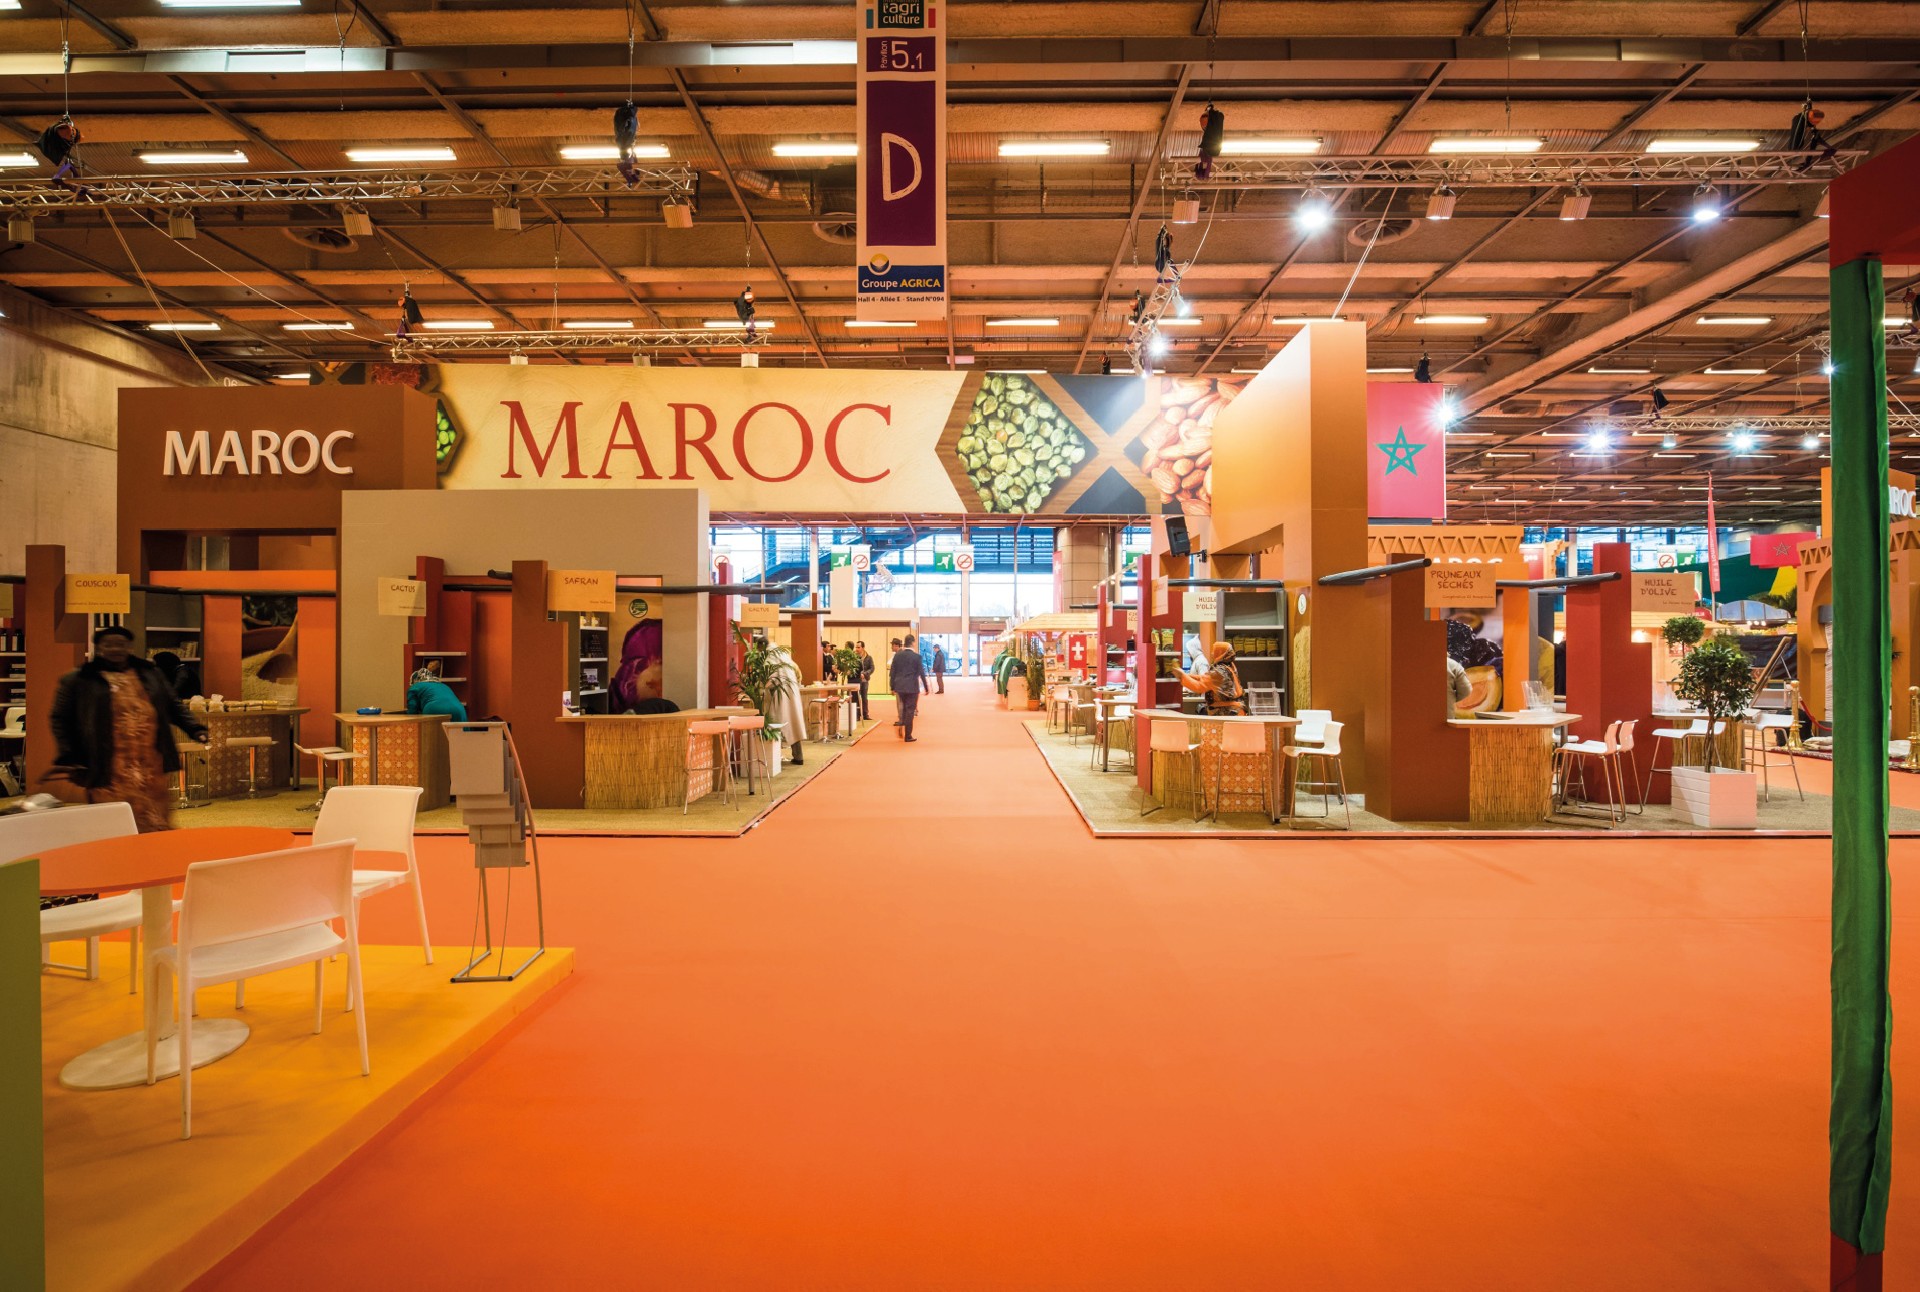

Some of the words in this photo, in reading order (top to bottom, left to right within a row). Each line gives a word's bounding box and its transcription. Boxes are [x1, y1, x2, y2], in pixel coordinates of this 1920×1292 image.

[882, 14, 920, 24] culture
[880, 40, 888, 69] Pavillon
[891, 40, 922, 70] 5.1
[881, 132, 922, 201] D
[861, 278, 898, 291] Groupe
[900, 278, 941, 288] AGRICA
[500, 401, 892, 482] MAROC
[162, 429, 354, 476] MAROC
[1430, 570, 1482, 580] PRUNEAUX
[75, 580, 118, 588] COUSCOUS
[564, 577, 599, 586] SAFRAN
[1644, 579, 1673, 588] HUILE
[390, 584, 417, 593] CACTUS
[1641, 587, 1678, 597] D'OLIVE
